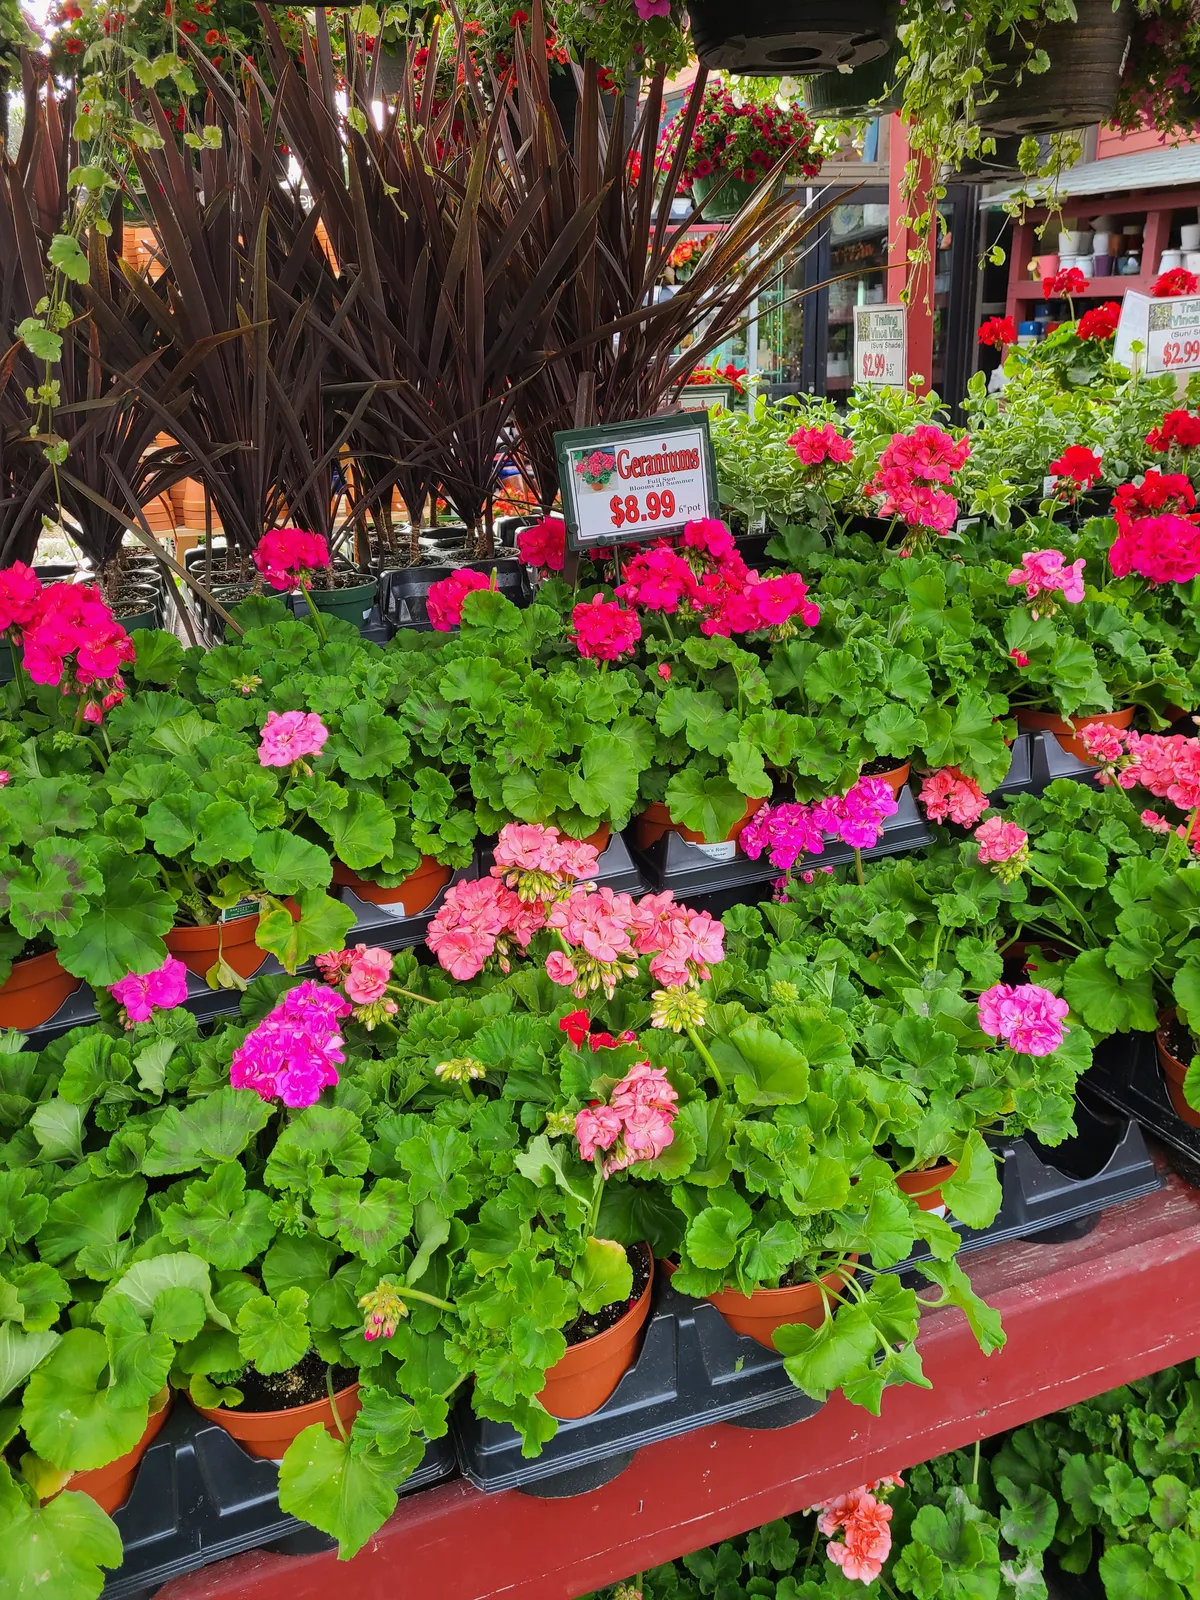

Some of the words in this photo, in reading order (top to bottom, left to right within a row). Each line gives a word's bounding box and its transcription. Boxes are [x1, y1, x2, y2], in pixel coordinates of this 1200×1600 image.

[1171, 315, 1200, 326] Vinca
[863, 352, 885, 378] $2.99
[1163, 340, 1200, 367] $2.99
[617, 443, 700, 479] Geraniums
[610, 490, 675, 528] $8.99
